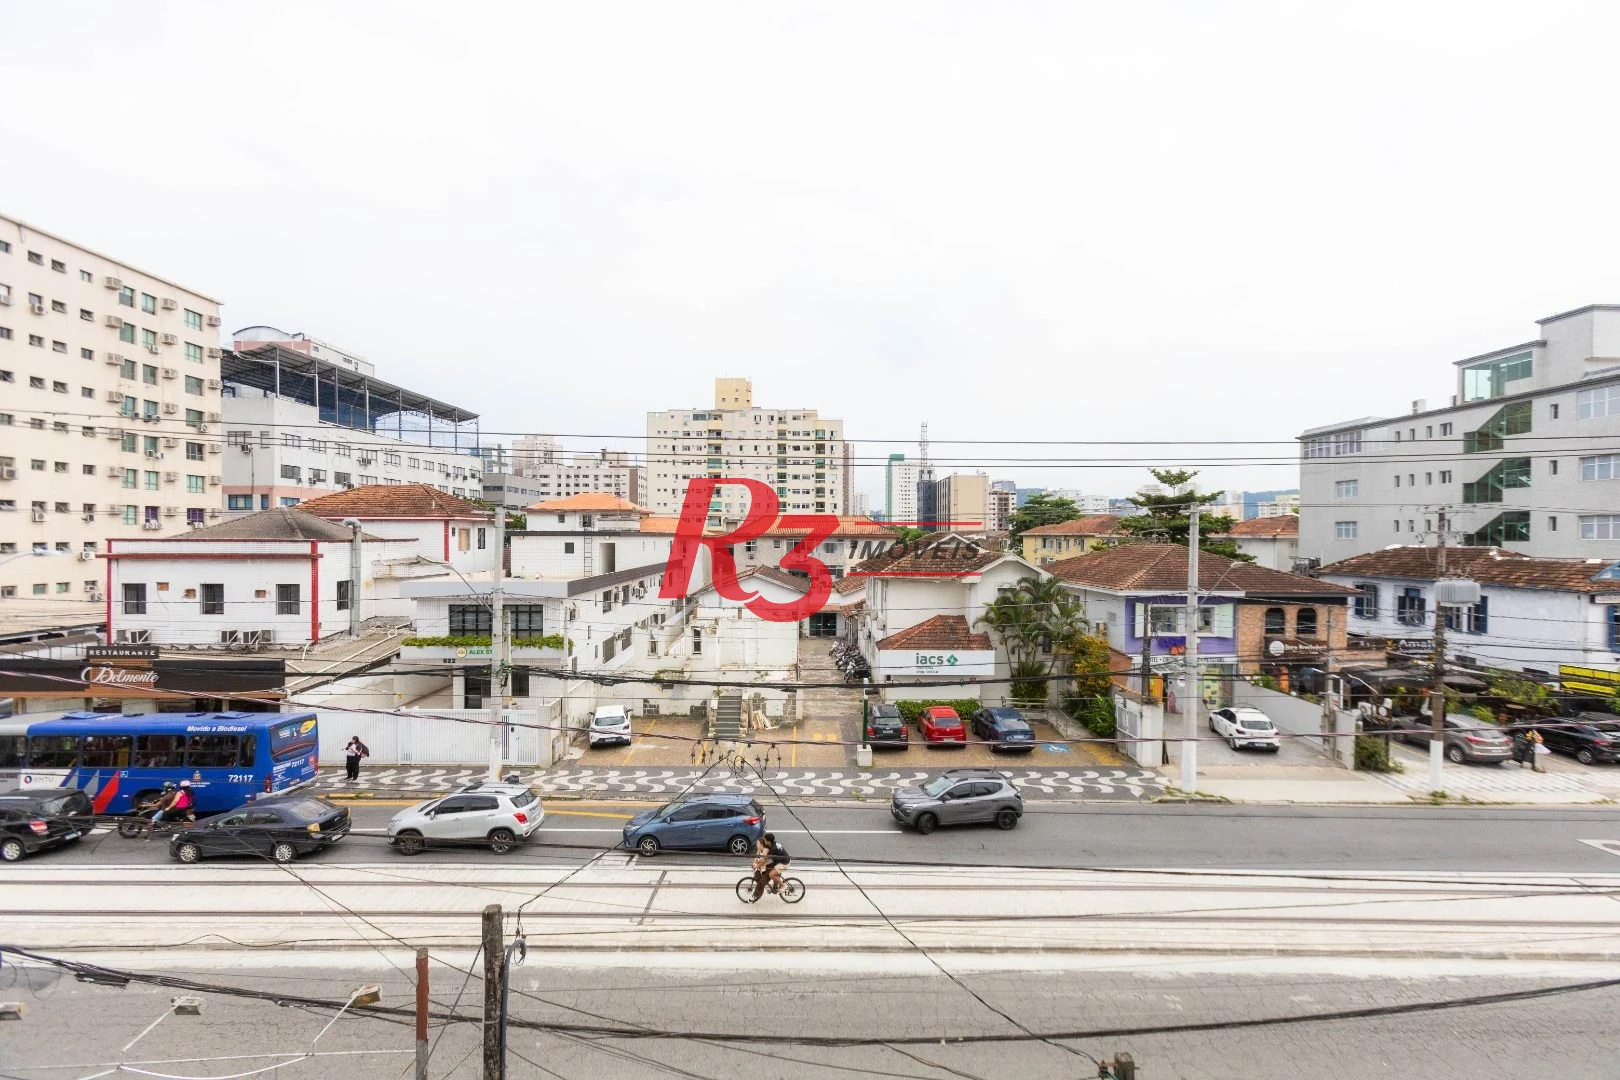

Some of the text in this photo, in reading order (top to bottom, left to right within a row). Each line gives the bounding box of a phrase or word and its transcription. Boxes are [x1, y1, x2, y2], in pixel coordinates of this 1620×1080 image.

[916, 652, 944, 665] iacs
[81, 662, 160, 684] Delmonte
[228, 774, 254, 783] 72117
